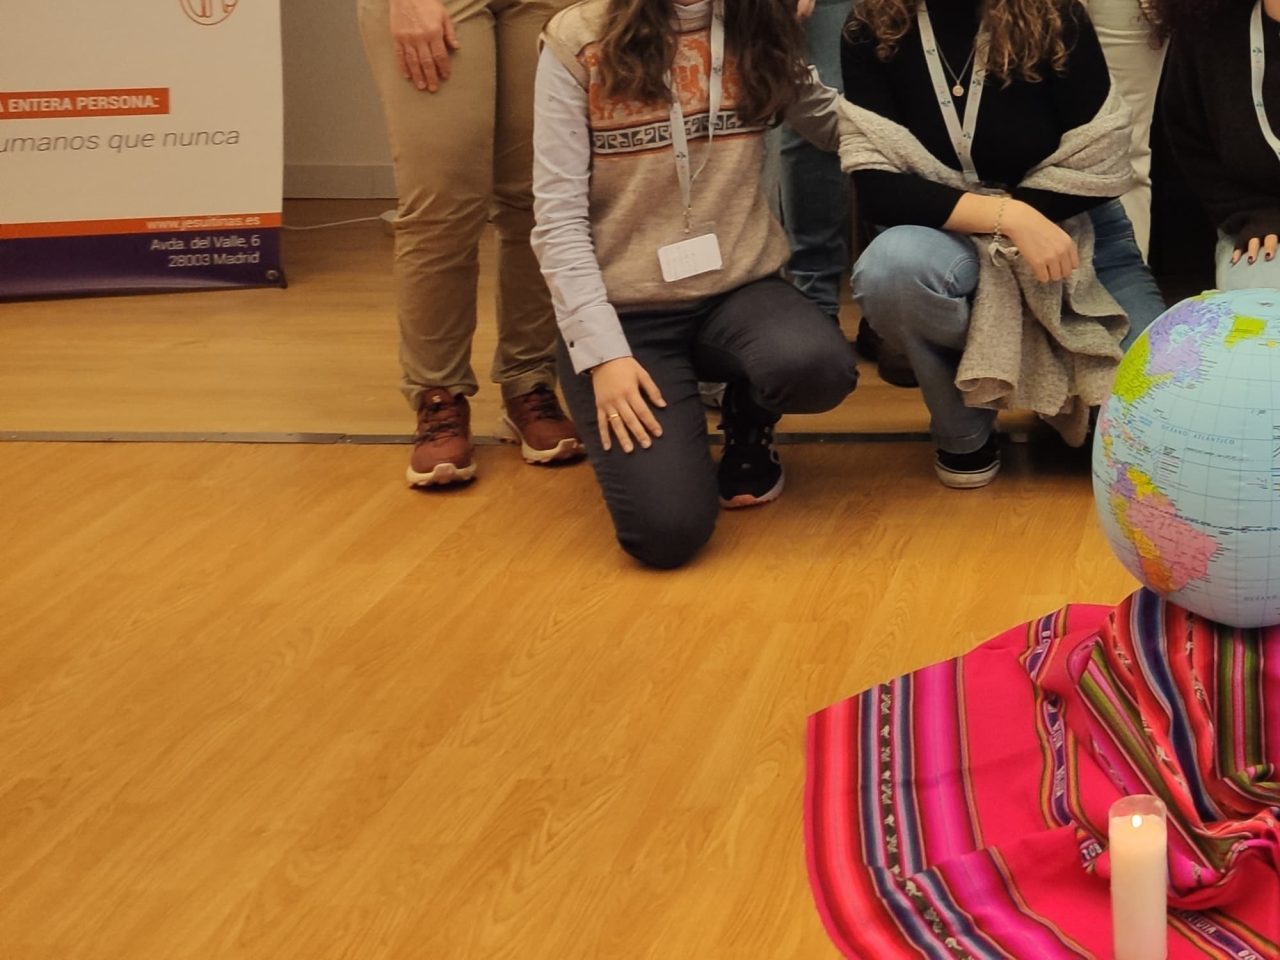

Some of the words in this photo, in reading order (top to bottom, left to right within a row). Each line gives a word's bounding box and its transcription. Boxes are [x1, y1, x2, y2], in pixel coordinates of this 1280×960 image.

[8, 96, 73, 113] ENTERA
[76, 94, 160, 111] PERSONA:
[108, 130, 155, 153] que
[162, 129, 241, 148] nunca
[190, 236, 210, 249] del
[250, 234, 261, 247] 6
[168, 253, 210, 268] 28003
[213, 250, 260, 265] Madrid
